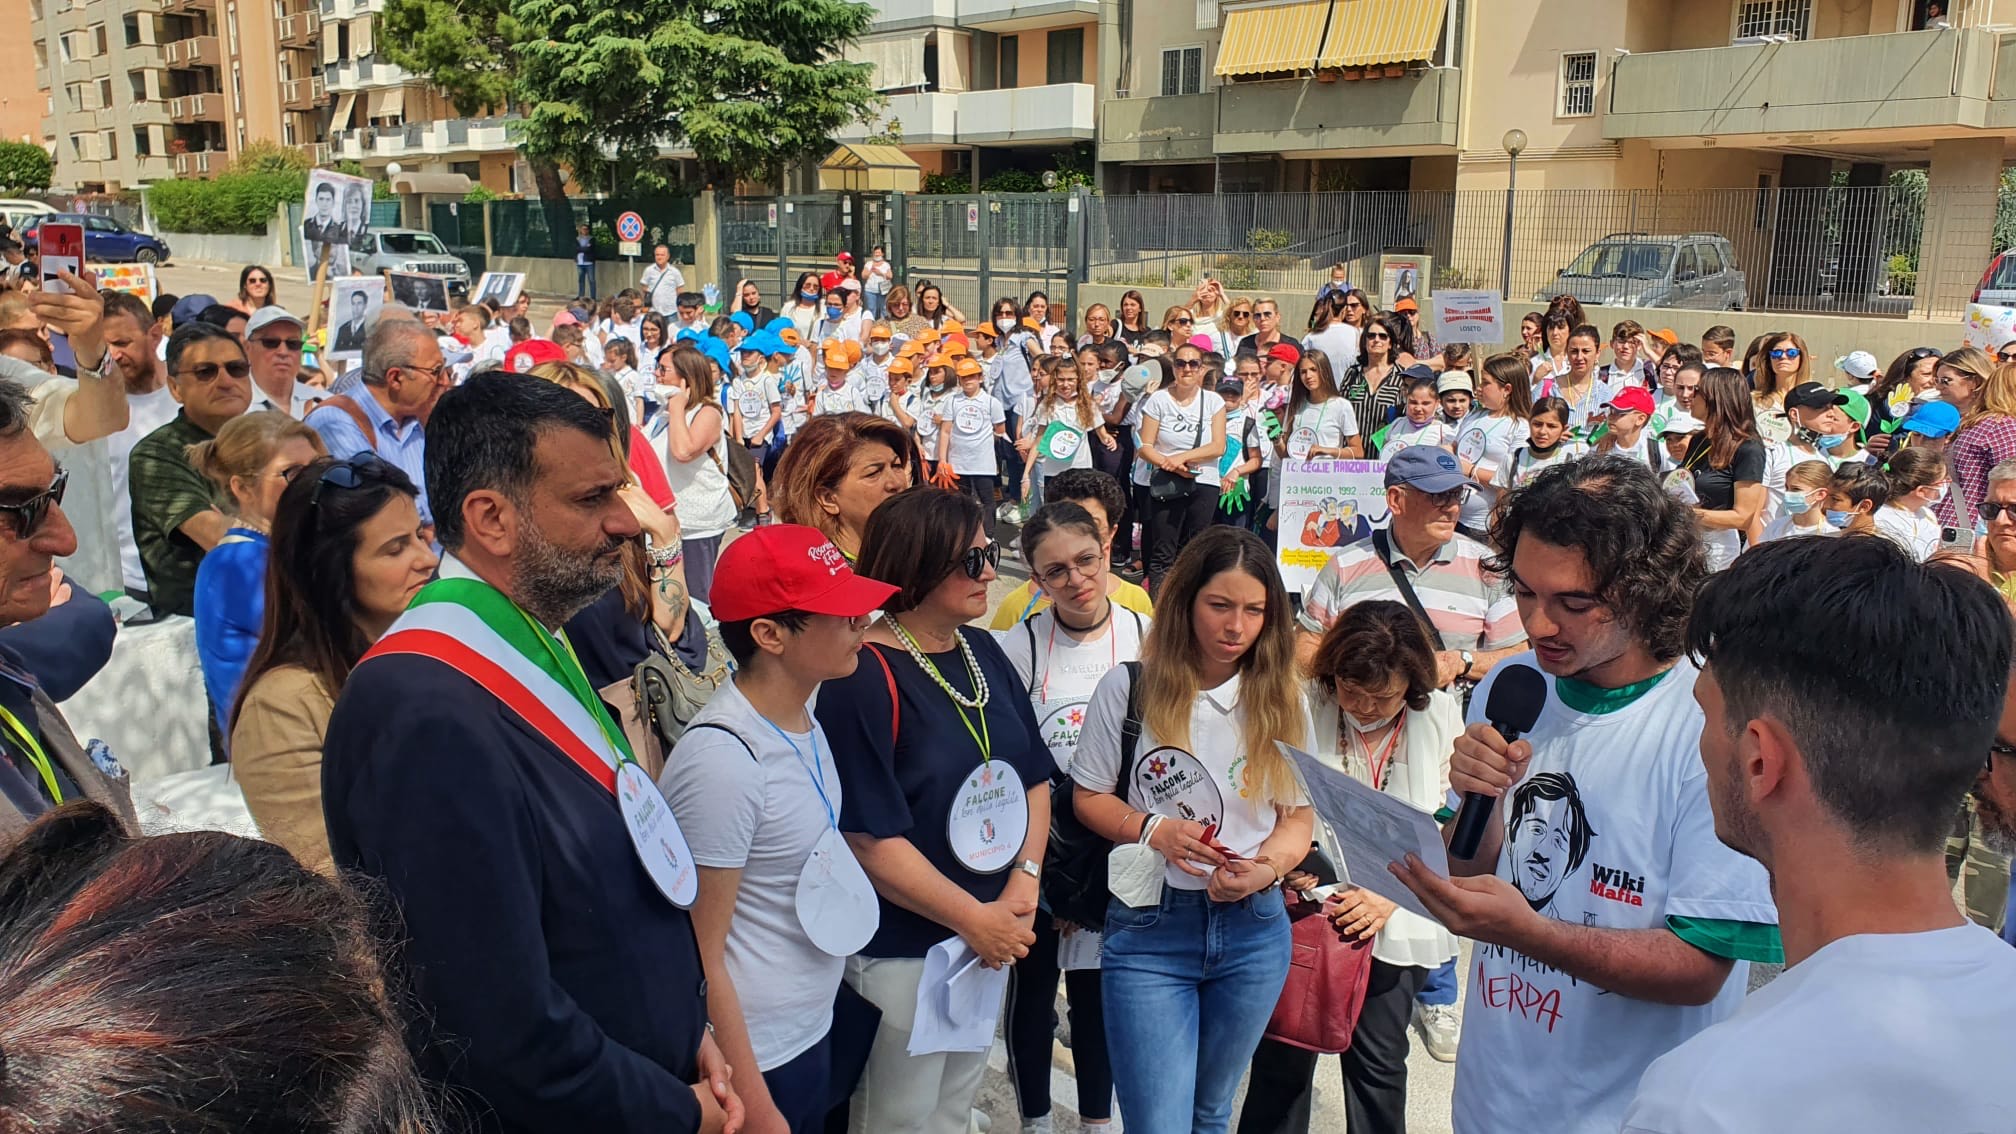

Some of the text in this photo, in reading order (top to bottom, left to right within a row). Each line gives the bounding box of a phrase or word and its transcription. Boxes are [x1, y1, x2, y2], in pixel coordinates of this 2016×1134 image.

[1300, 462, 1330, 474] CEGLIE
[1333, 460, 1370, 474] MANZONI
[1372, 461, 1387, 474] LUC
[1286, 486, 1299, 495] 23
[1300, 486, 1333, 496] MAGGIO
[1338, 486, 1357, 496] 1992
[1370, 486, 1387, 496] 202
[1052, 729, 1079, 741] FALC
[1150, 770, 1187, 796] FALCONE
[966, 786, 1006, 808] FALCONE
[1592, 862, 1645, 894] Wiki
[1589, 879, 1643, 907] Mafia
